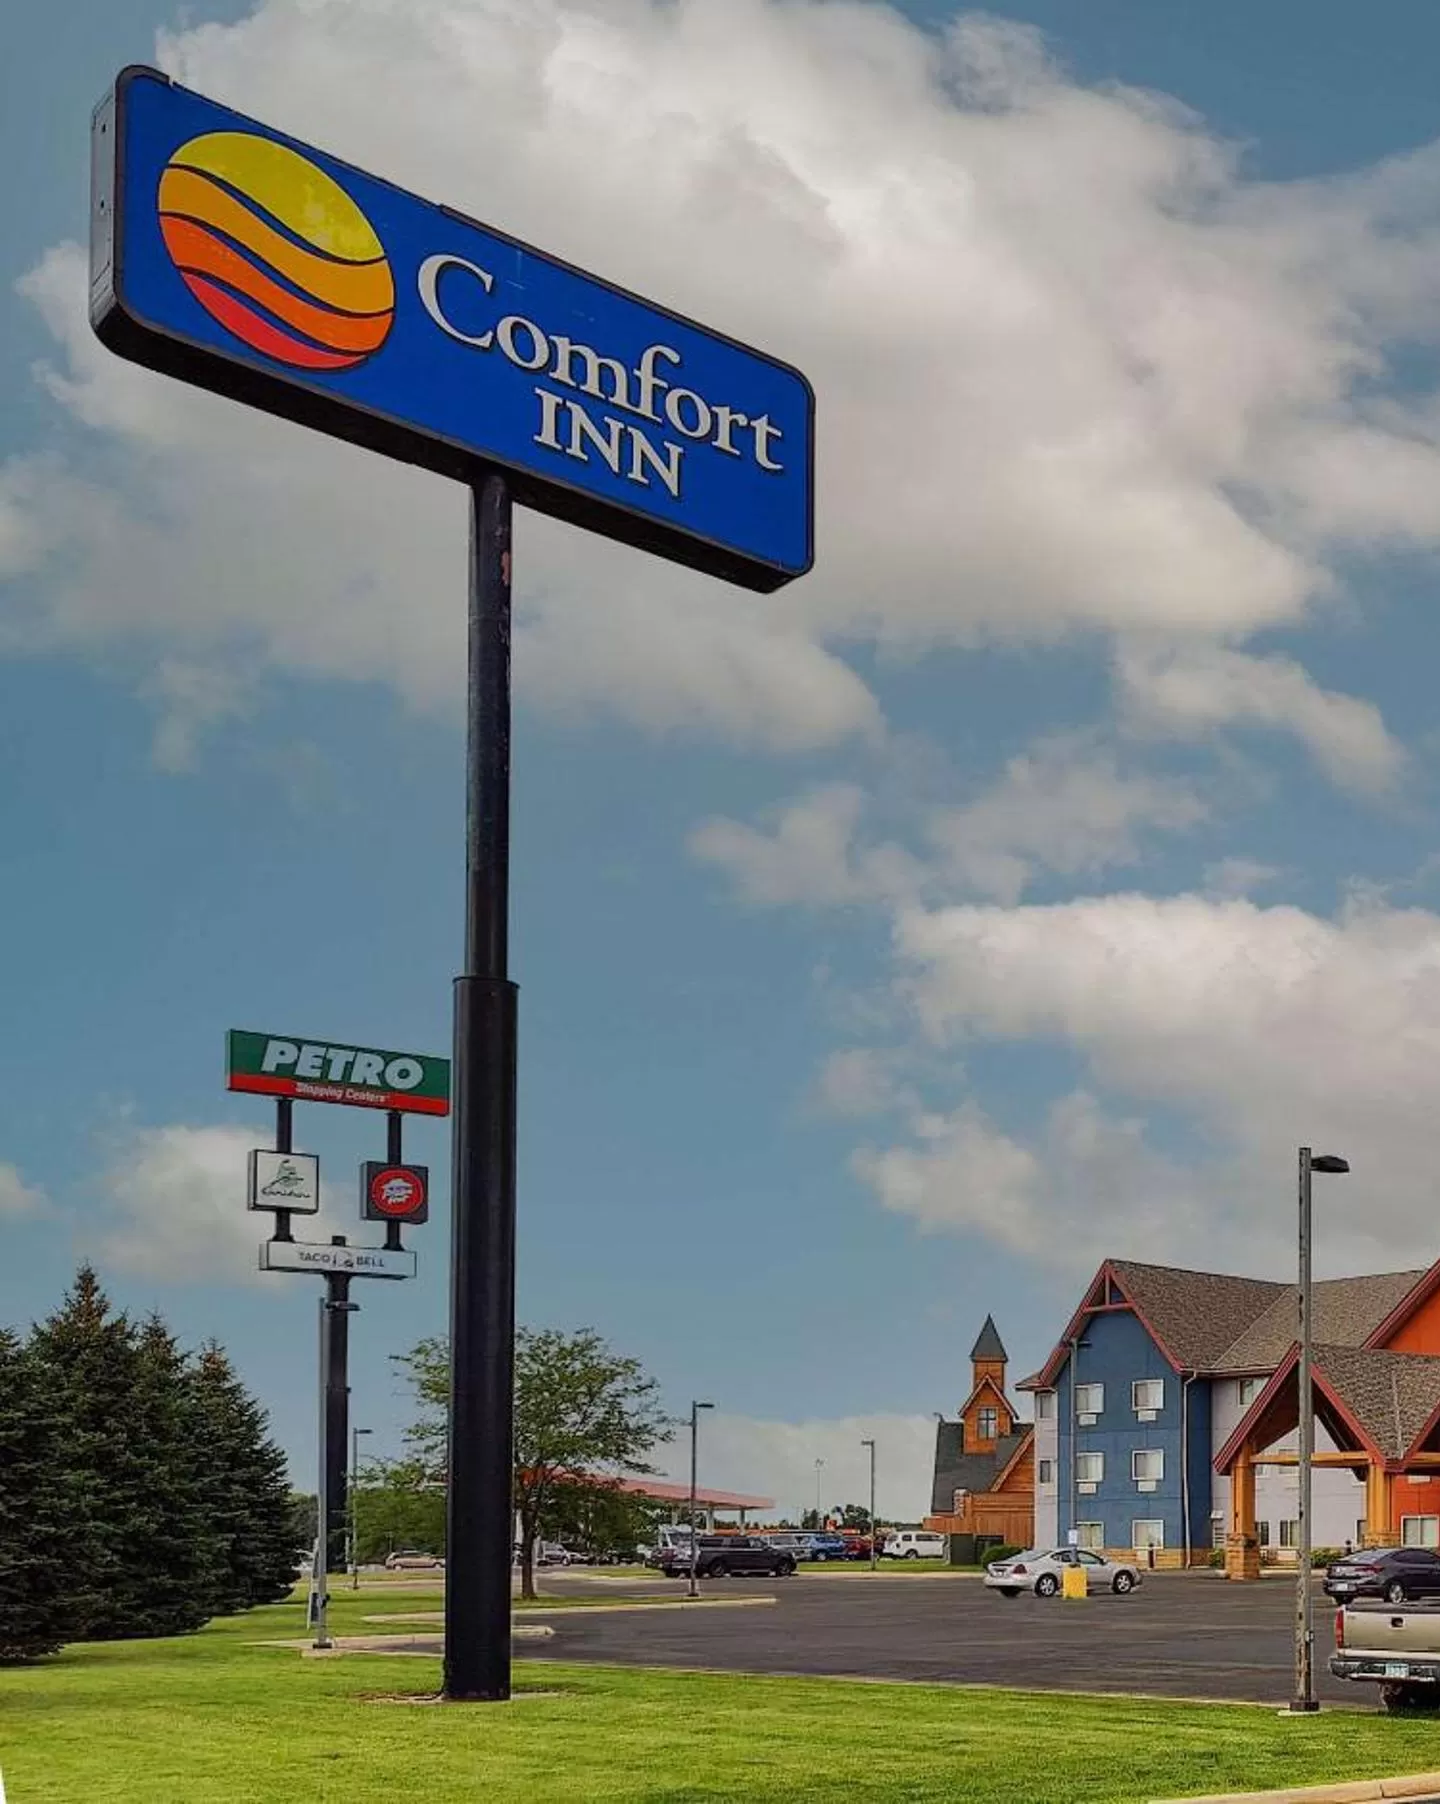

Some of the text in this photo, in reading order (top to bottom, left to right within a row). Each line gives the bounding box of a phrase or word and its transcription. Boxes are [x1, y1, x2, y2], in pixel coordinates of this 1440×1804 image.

[417, 254, 785, 471] Comfort
[532, 386, 685, 497] INN
[260, 1039, 424, 1090] PETRO
[300, 1251, 385, 1268] TACO BELL
